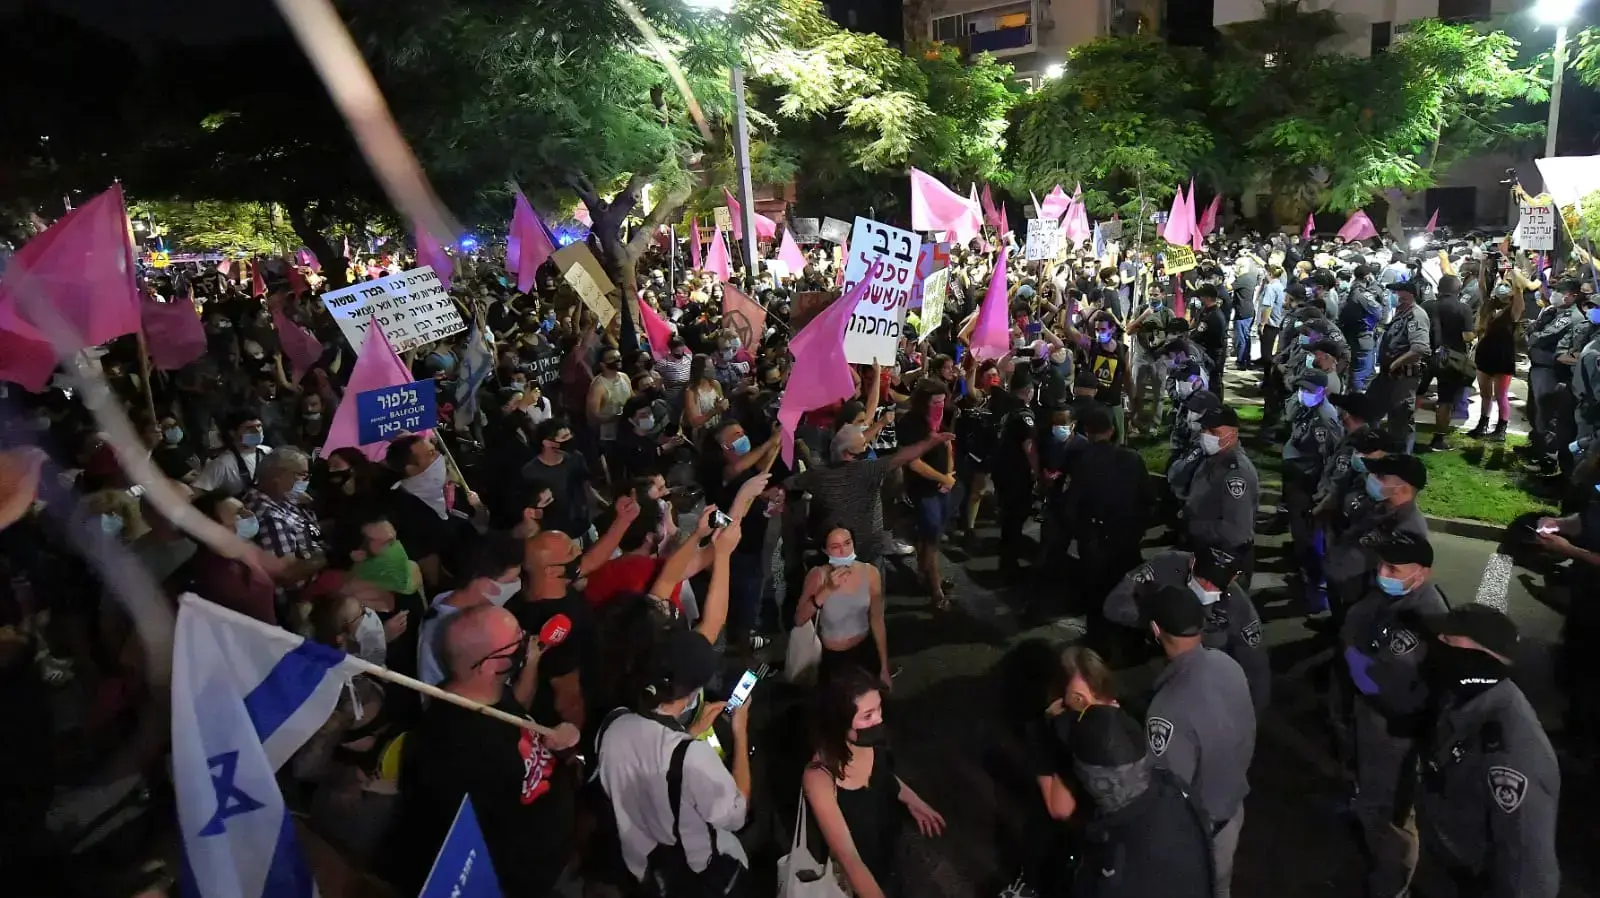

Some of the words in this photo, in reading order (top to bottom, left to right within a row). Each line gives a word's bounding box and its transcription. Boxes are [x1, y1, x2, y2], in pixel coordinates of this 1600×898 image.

[360, 286, 385, 298] הפרד
[329, 293, 357, 308] ומשול
[348, 305, 375, 318] שמאל
[377, 387, 418, 409] בלפור
[390, 405, 424, 418] BALFOUR
[378, 421, 401, 436] כאן
[406, 416, 419, 428] זה
